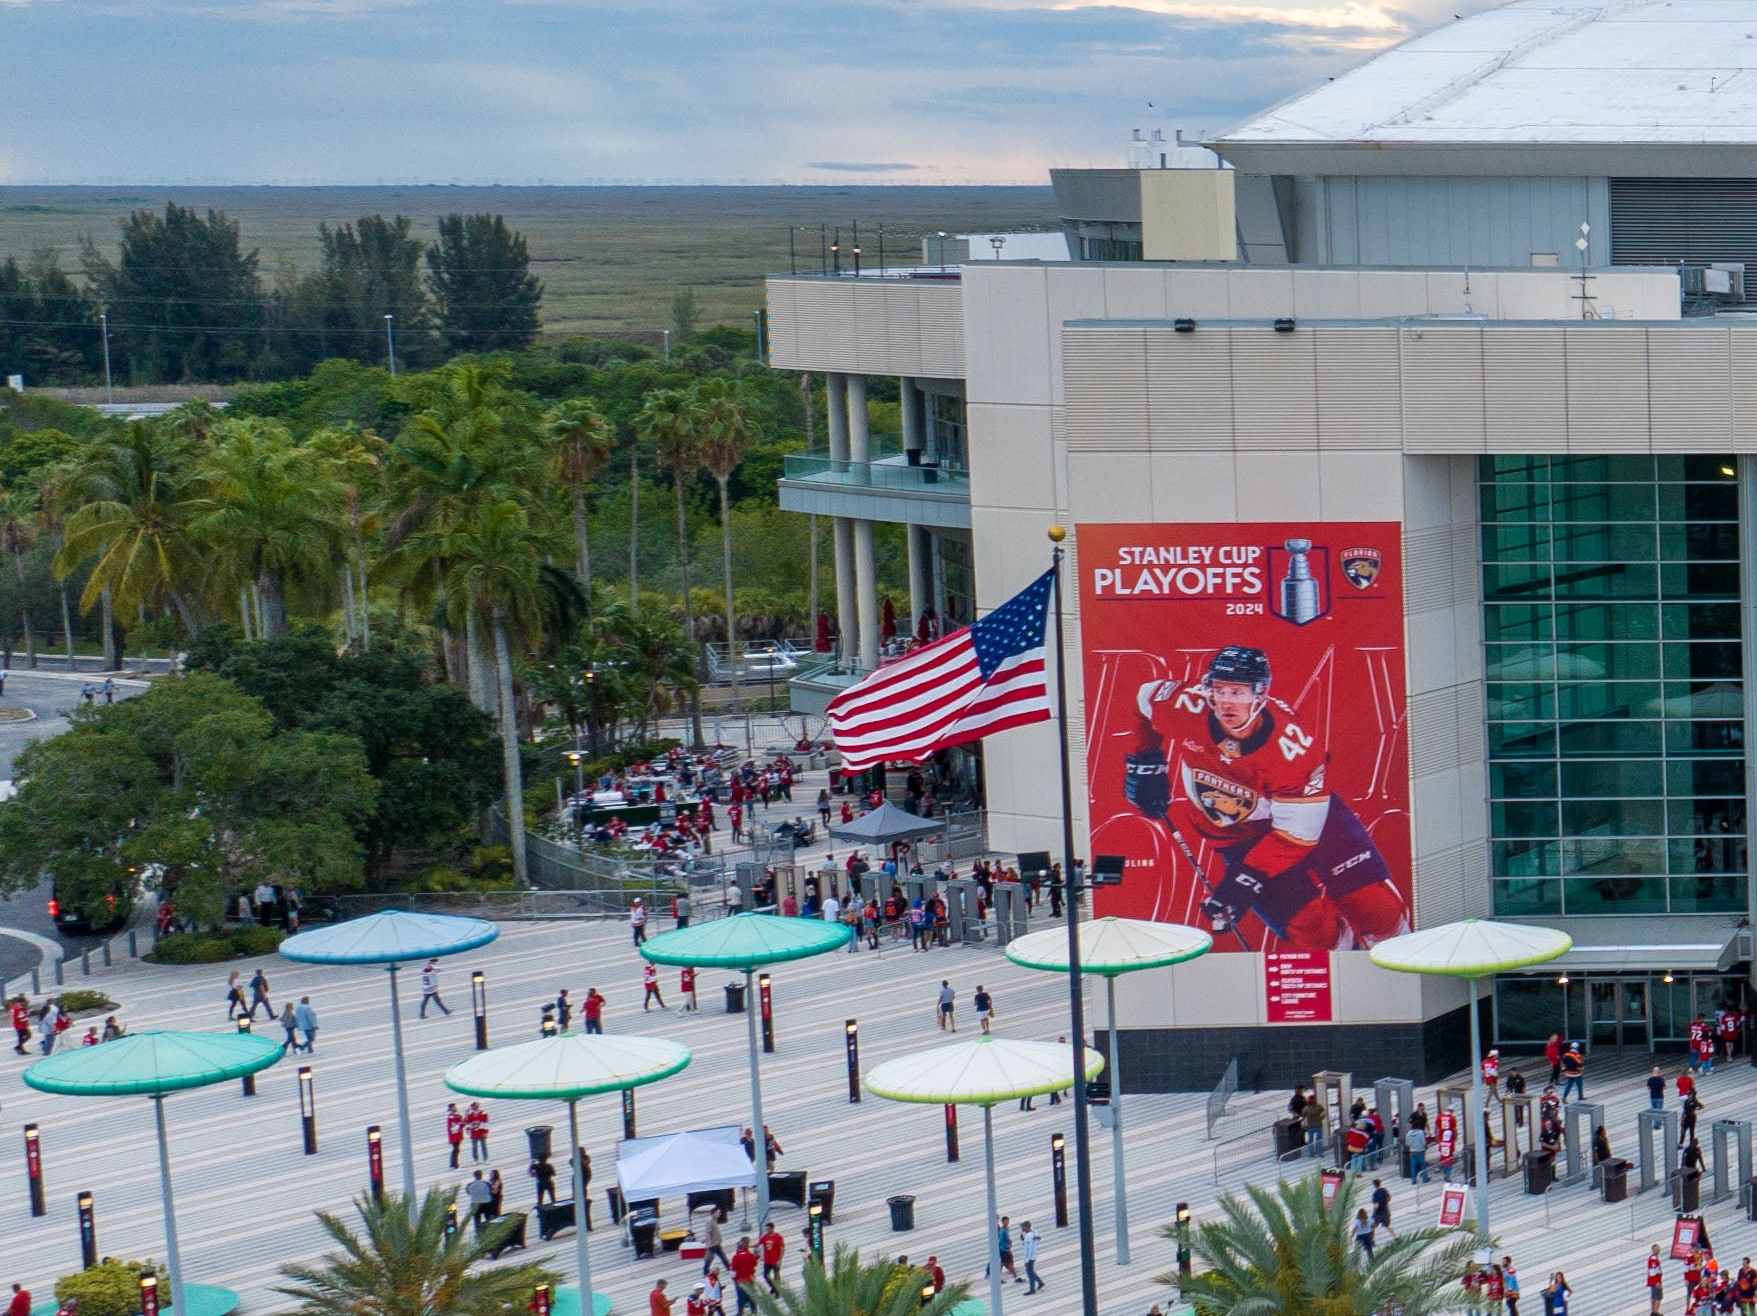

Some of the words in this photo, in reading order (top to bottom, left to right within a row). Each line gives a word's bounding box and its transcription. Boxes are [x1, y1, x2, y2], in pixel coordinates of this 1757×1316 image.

[1118, 546, 1214, 565] STANLEY
[1218, 546, 1261, 565] CUP
[1094, 567, 1263, 595] PLAYOFFS
[1226, 603, 1264, 615] 2024
[1278, 723, 1314, 762] 42
[1197, 770, 1252, 798] PANTHERS
